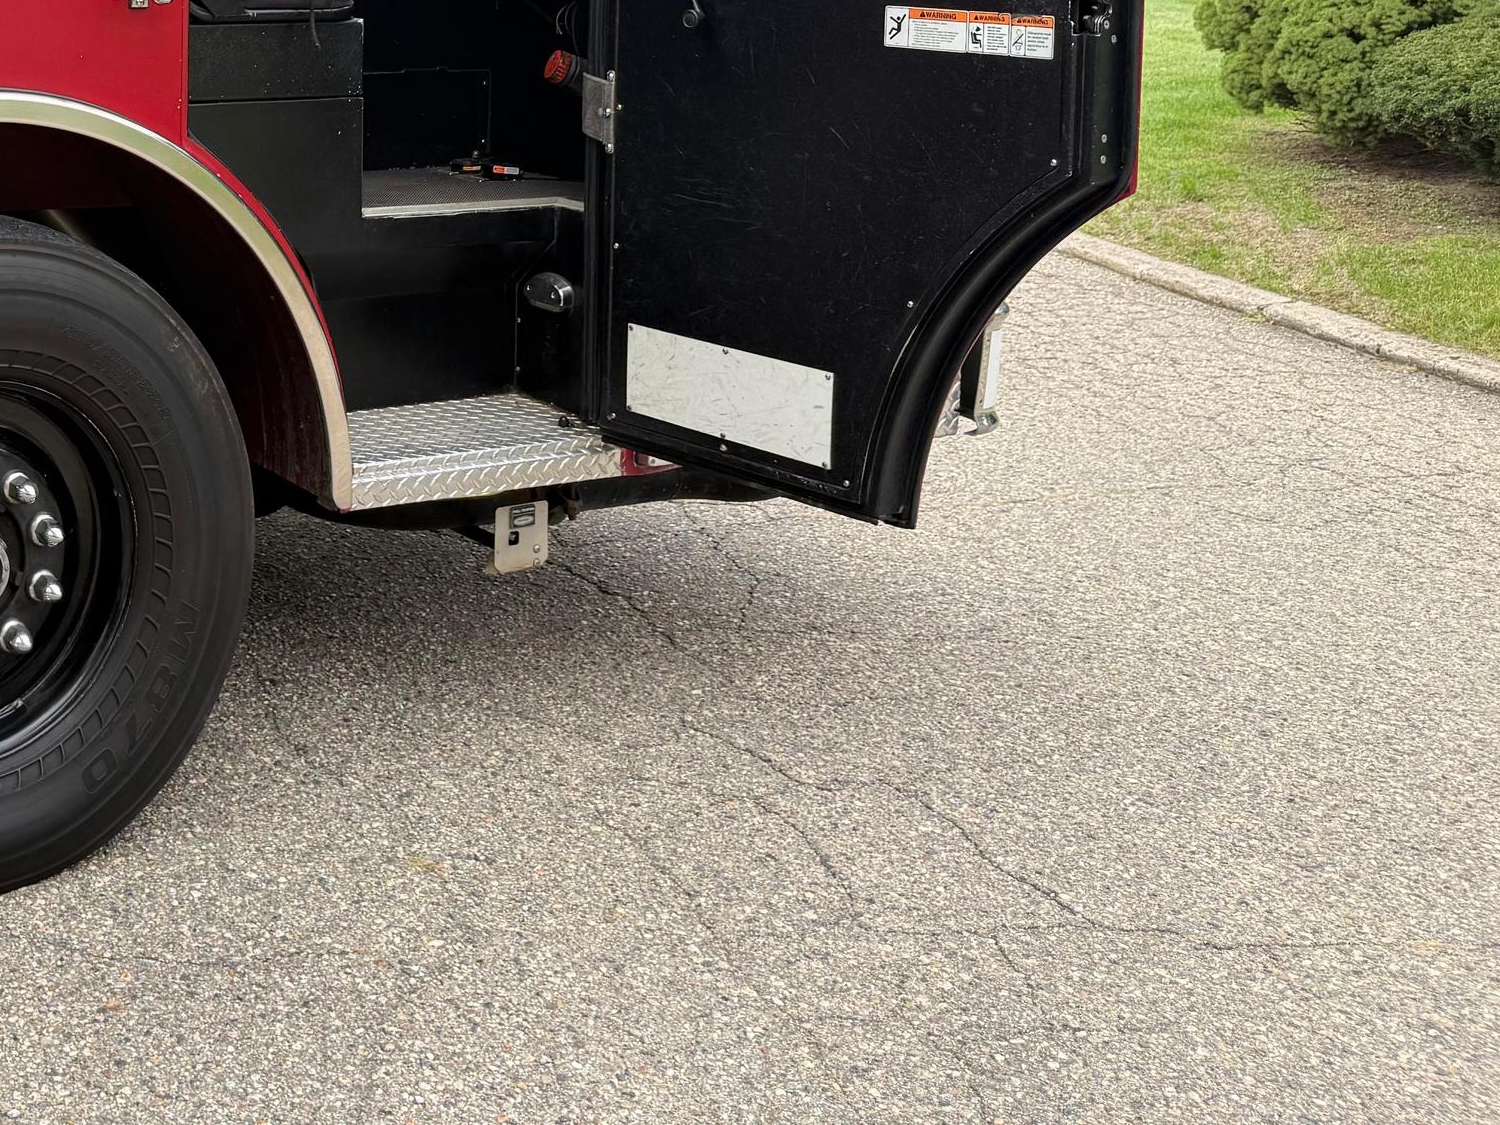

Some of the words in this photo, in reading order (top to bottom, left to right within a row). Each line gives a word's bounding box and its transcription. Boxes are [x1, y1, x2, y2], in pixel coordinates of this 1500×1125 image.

[926, 11, 957, 20] WARNING
[979, 15, 1005, 23] WARNING
[1021, 18, 1049, 26] WARNING
